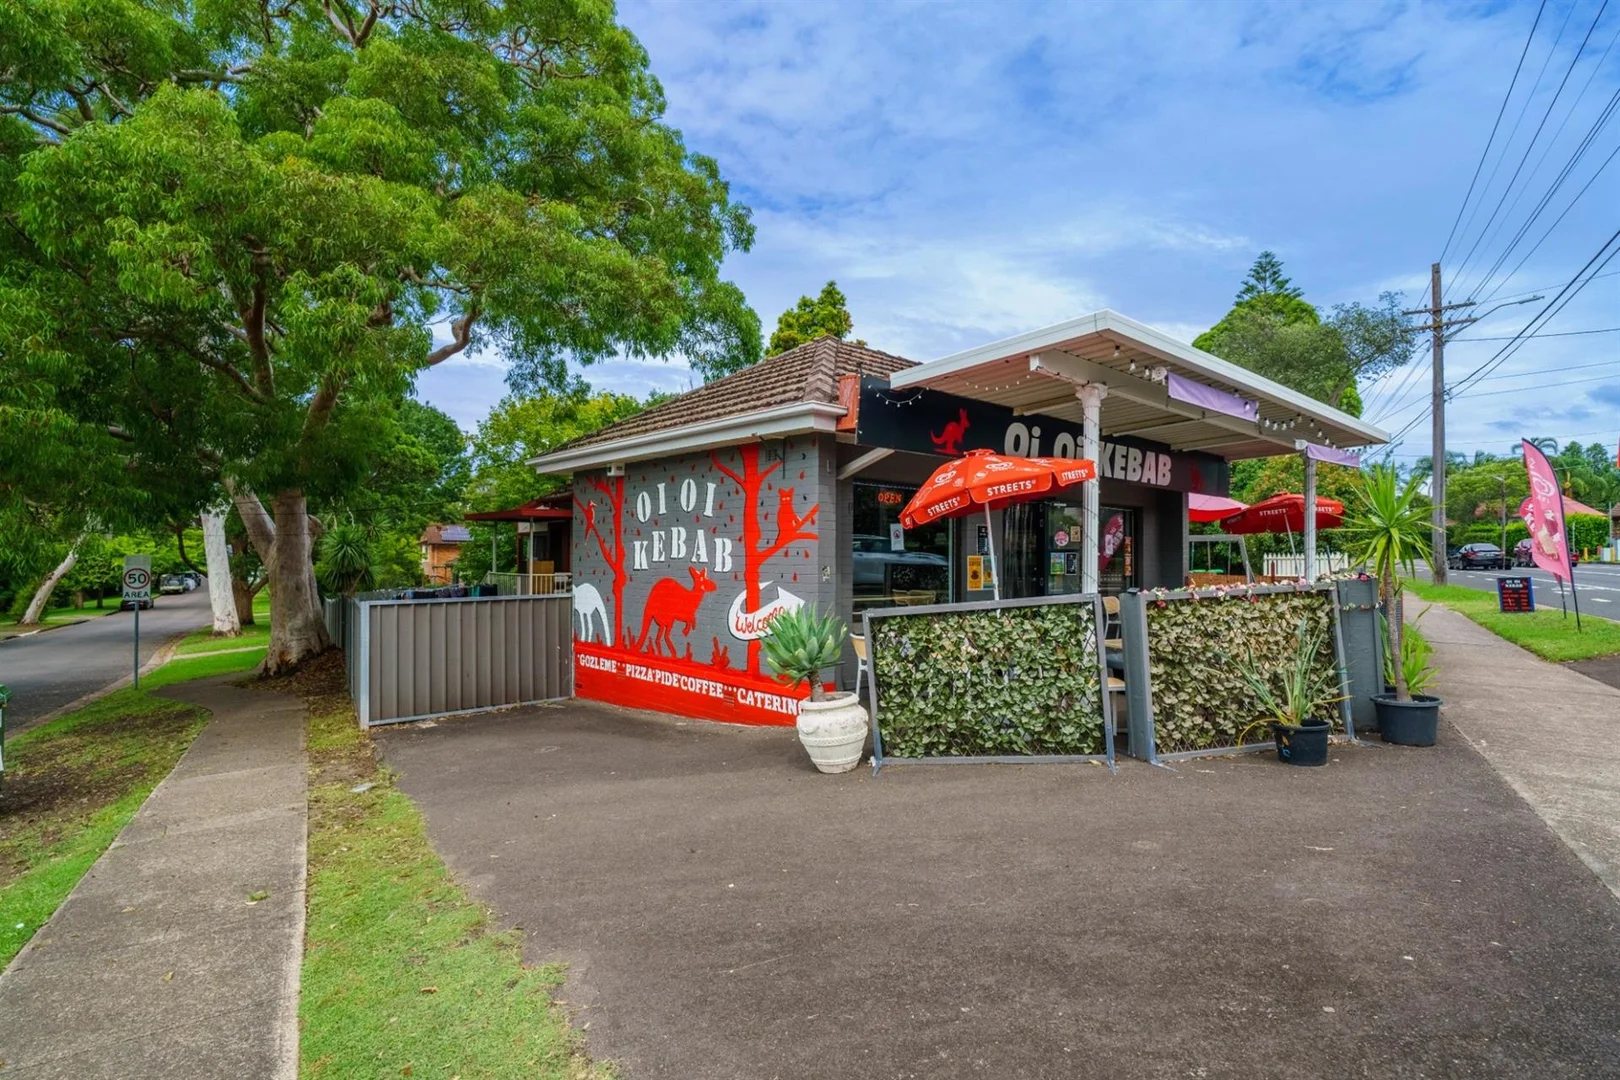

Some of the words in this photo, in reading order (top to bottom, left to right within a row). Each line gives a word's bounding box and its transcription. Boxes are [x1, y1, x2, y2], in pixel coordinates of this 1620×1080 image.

[1100, 441, 1172, 486] KEBAB
[878, 491, 902, 504] OPEN
[986, 480, 1032, 496] STREETS
[637, 483, 667, 523] OI
[680, 478, 717, 517] OI
[927, 498, 957, 517] STREETS
[633, 526, 733, 573] KEBAB
[128, 573, 147, 585] 50
[124, 591, 150, 599] AREA
[737, 688, 801, 716] CATERIN
